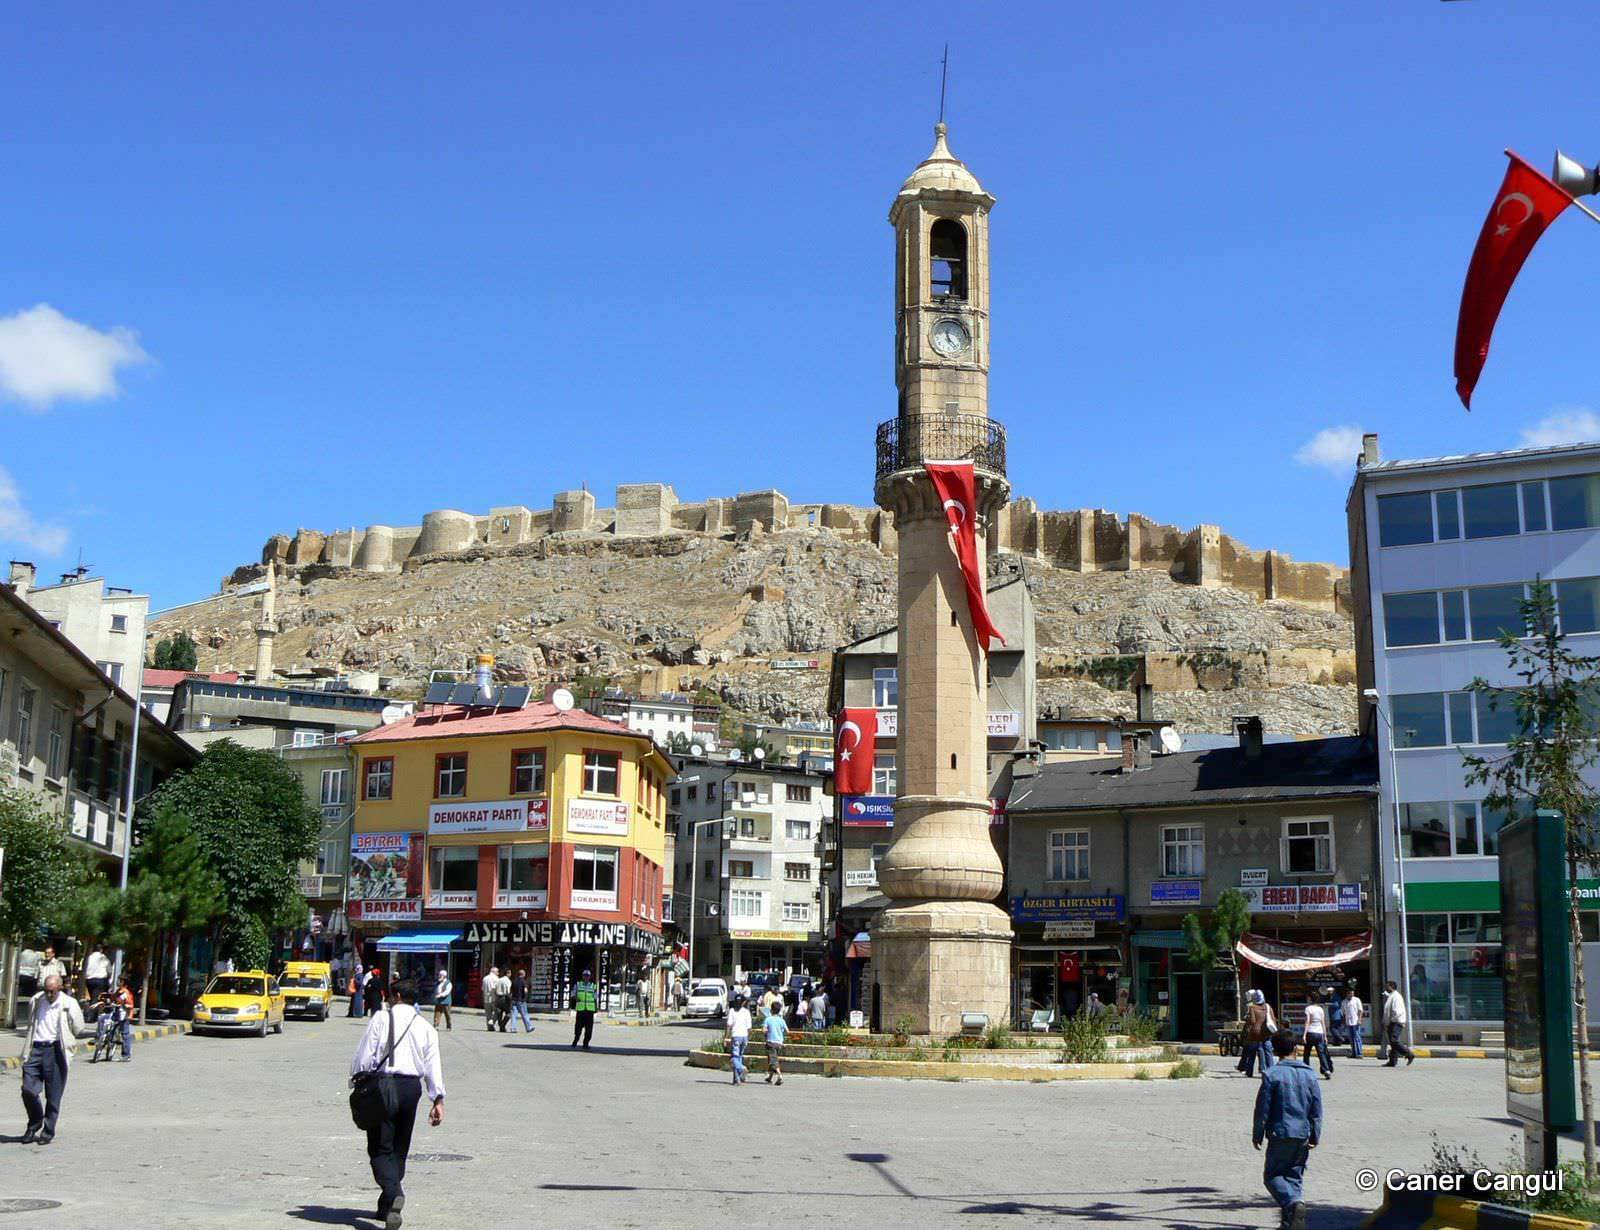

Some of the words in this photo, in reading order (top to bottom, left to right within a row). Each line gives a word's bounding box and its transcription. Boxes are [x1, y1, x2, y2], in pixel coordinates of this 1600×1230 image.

[533, 801, 543, 809] DP
[434, 810, 489, 824] DEMOKRAT
[492, 808, 522, 821] PARTİ
[571, 807, 598, 819] DEMOKRAT
[357, 835, 402, 848] BAYRAK
[1301, 886, 1337, 904] BABA
[365, 901, 417, 913] BAYRAK
